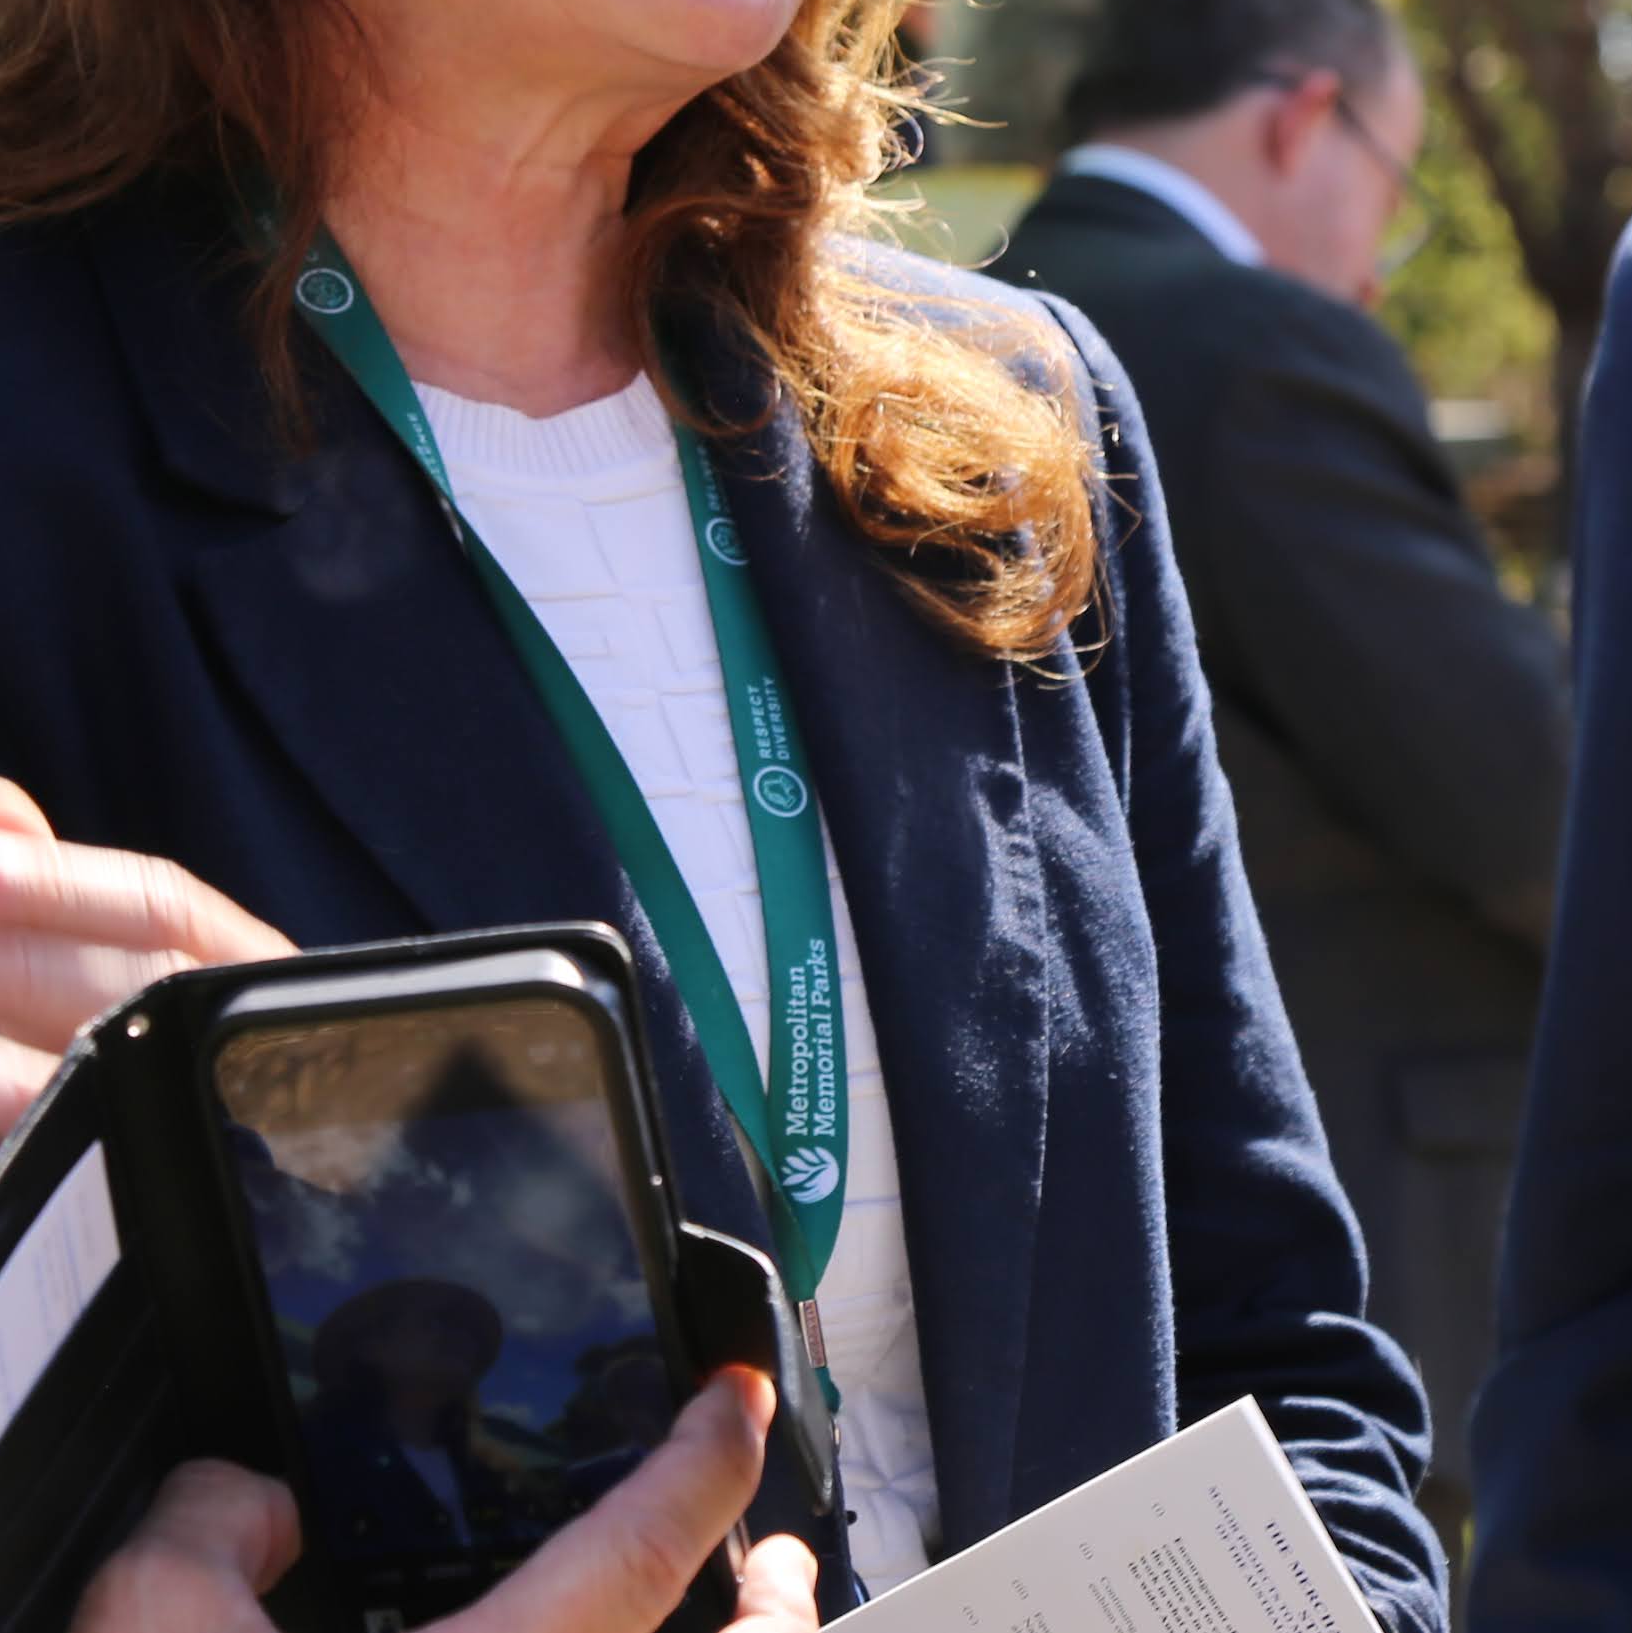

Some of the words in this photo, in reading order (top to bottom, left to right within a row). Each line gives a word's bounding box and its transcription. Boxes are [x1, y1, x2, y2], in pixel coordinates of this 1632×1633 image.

[747, 684, 773, 760] RESPECT
[765, 676, 791, 761] DIVERSITY
[807, 938, 832, 1008] Parks
[785, 966, 813, 1136] Metropolitan
[810, 1012, 837, 1137] Memorial
[1228, 1545, 1246, 1569] THE
[1266, 1521, 1291, 1555] THE
